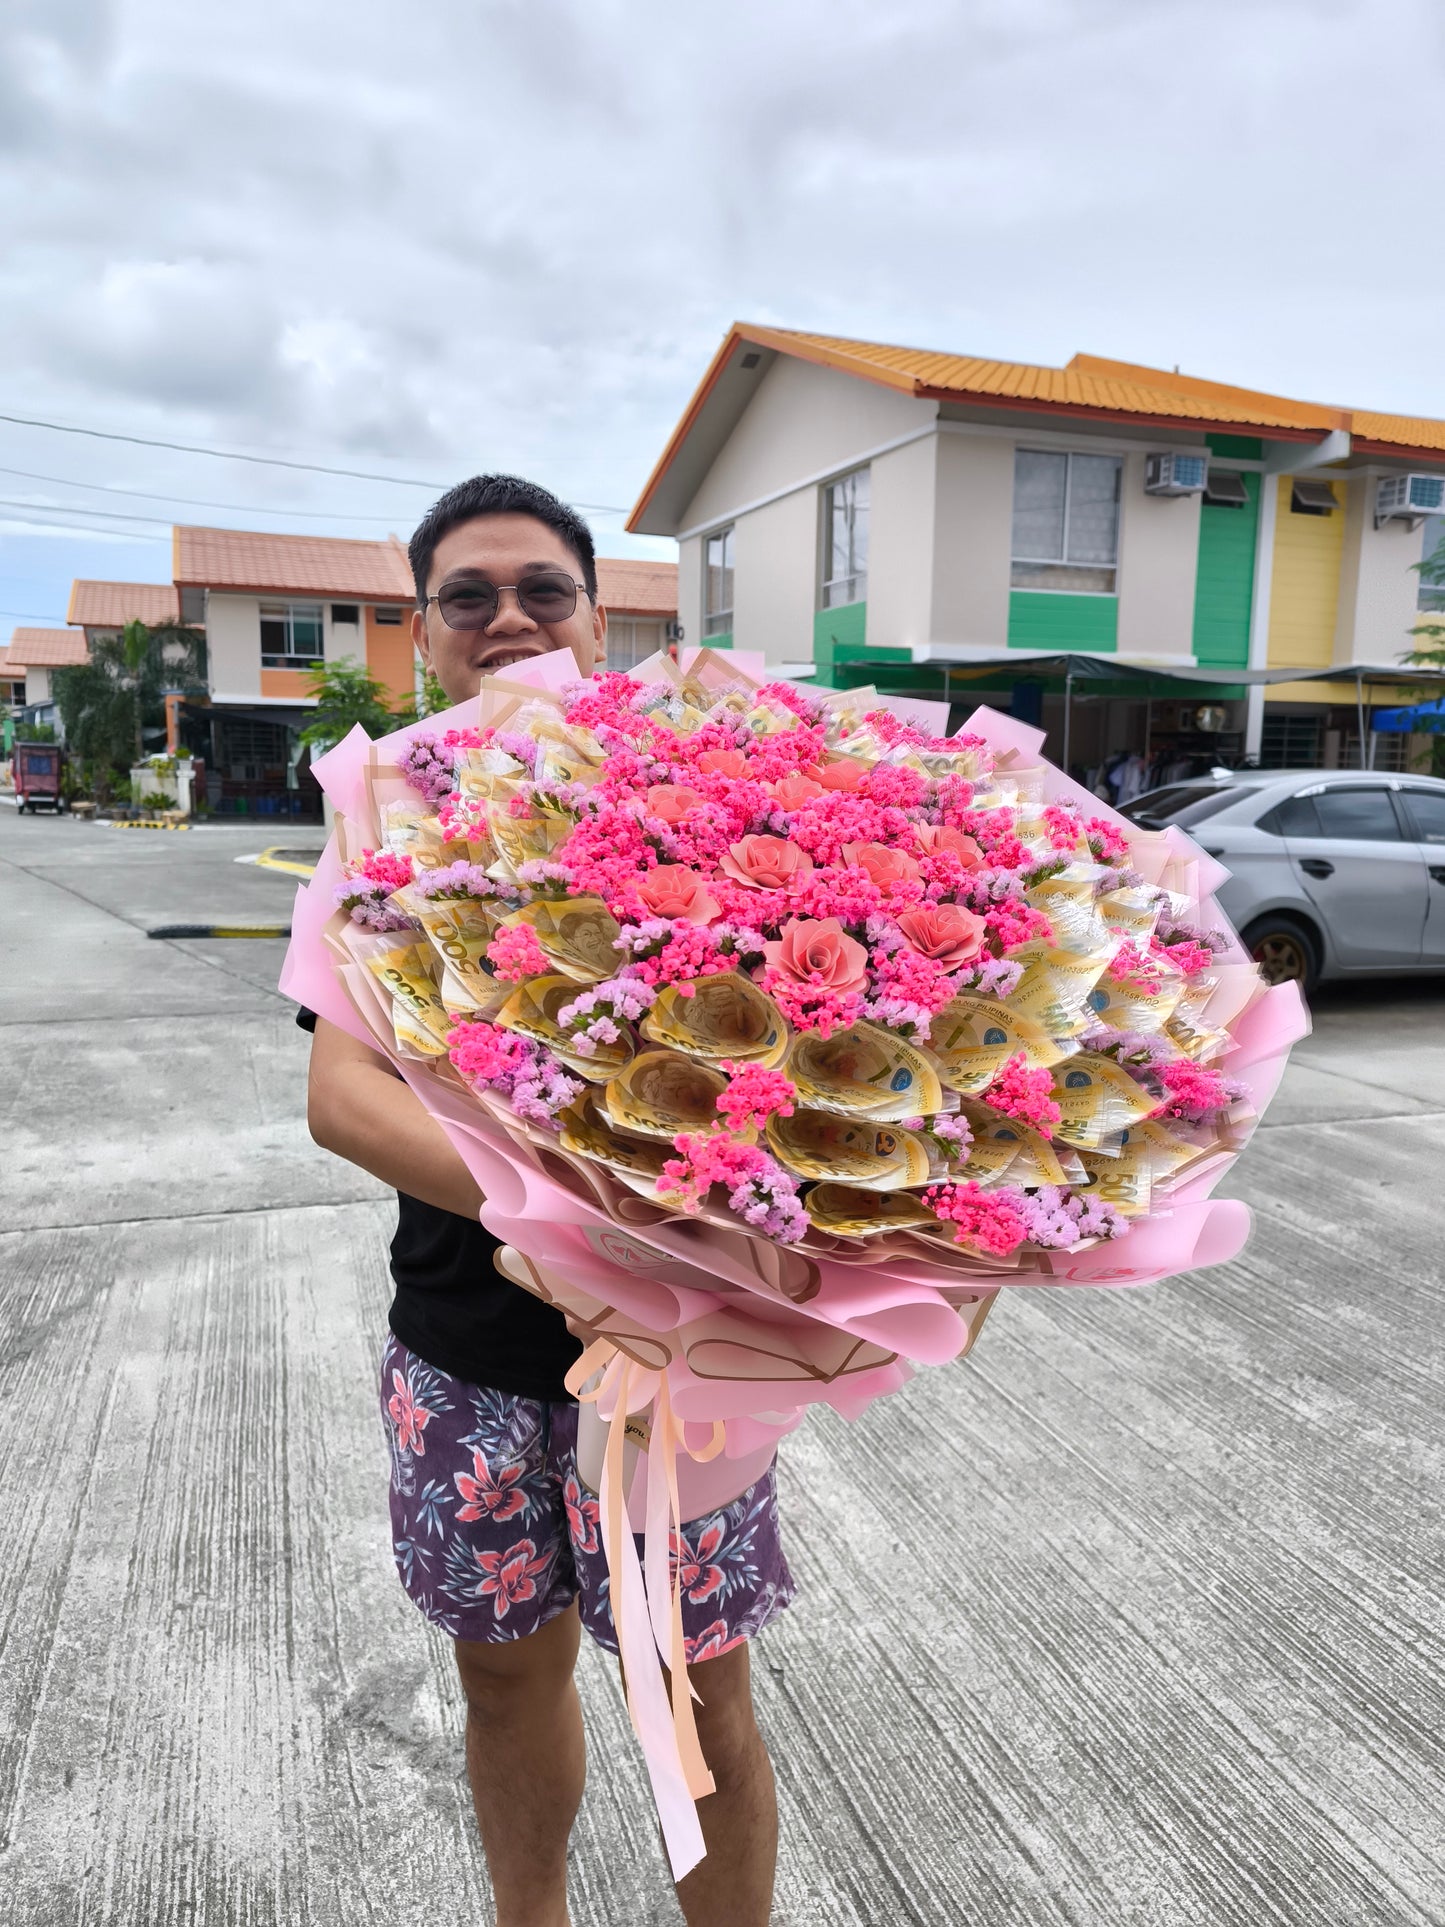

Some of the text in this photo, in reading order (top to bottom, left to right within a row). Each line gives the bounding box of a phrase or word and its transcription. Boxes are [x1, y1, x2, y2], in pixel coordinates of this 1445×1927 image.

[431, 920, 480, 976] 500
[384, 968, 431, 1010] 500
[976, 1003, 1015, 1024] PILIPINAS
[1038, 1003, 1075, 1037] 500
[889, 1039, 923, 1071] PILIPINAS
[623, 1110, 679, 1133] 500
[1057, 1119, 1088, 1141] 500
[569, 1133, 633, 1169] 500
[624, 1424, 646, 1440] you
